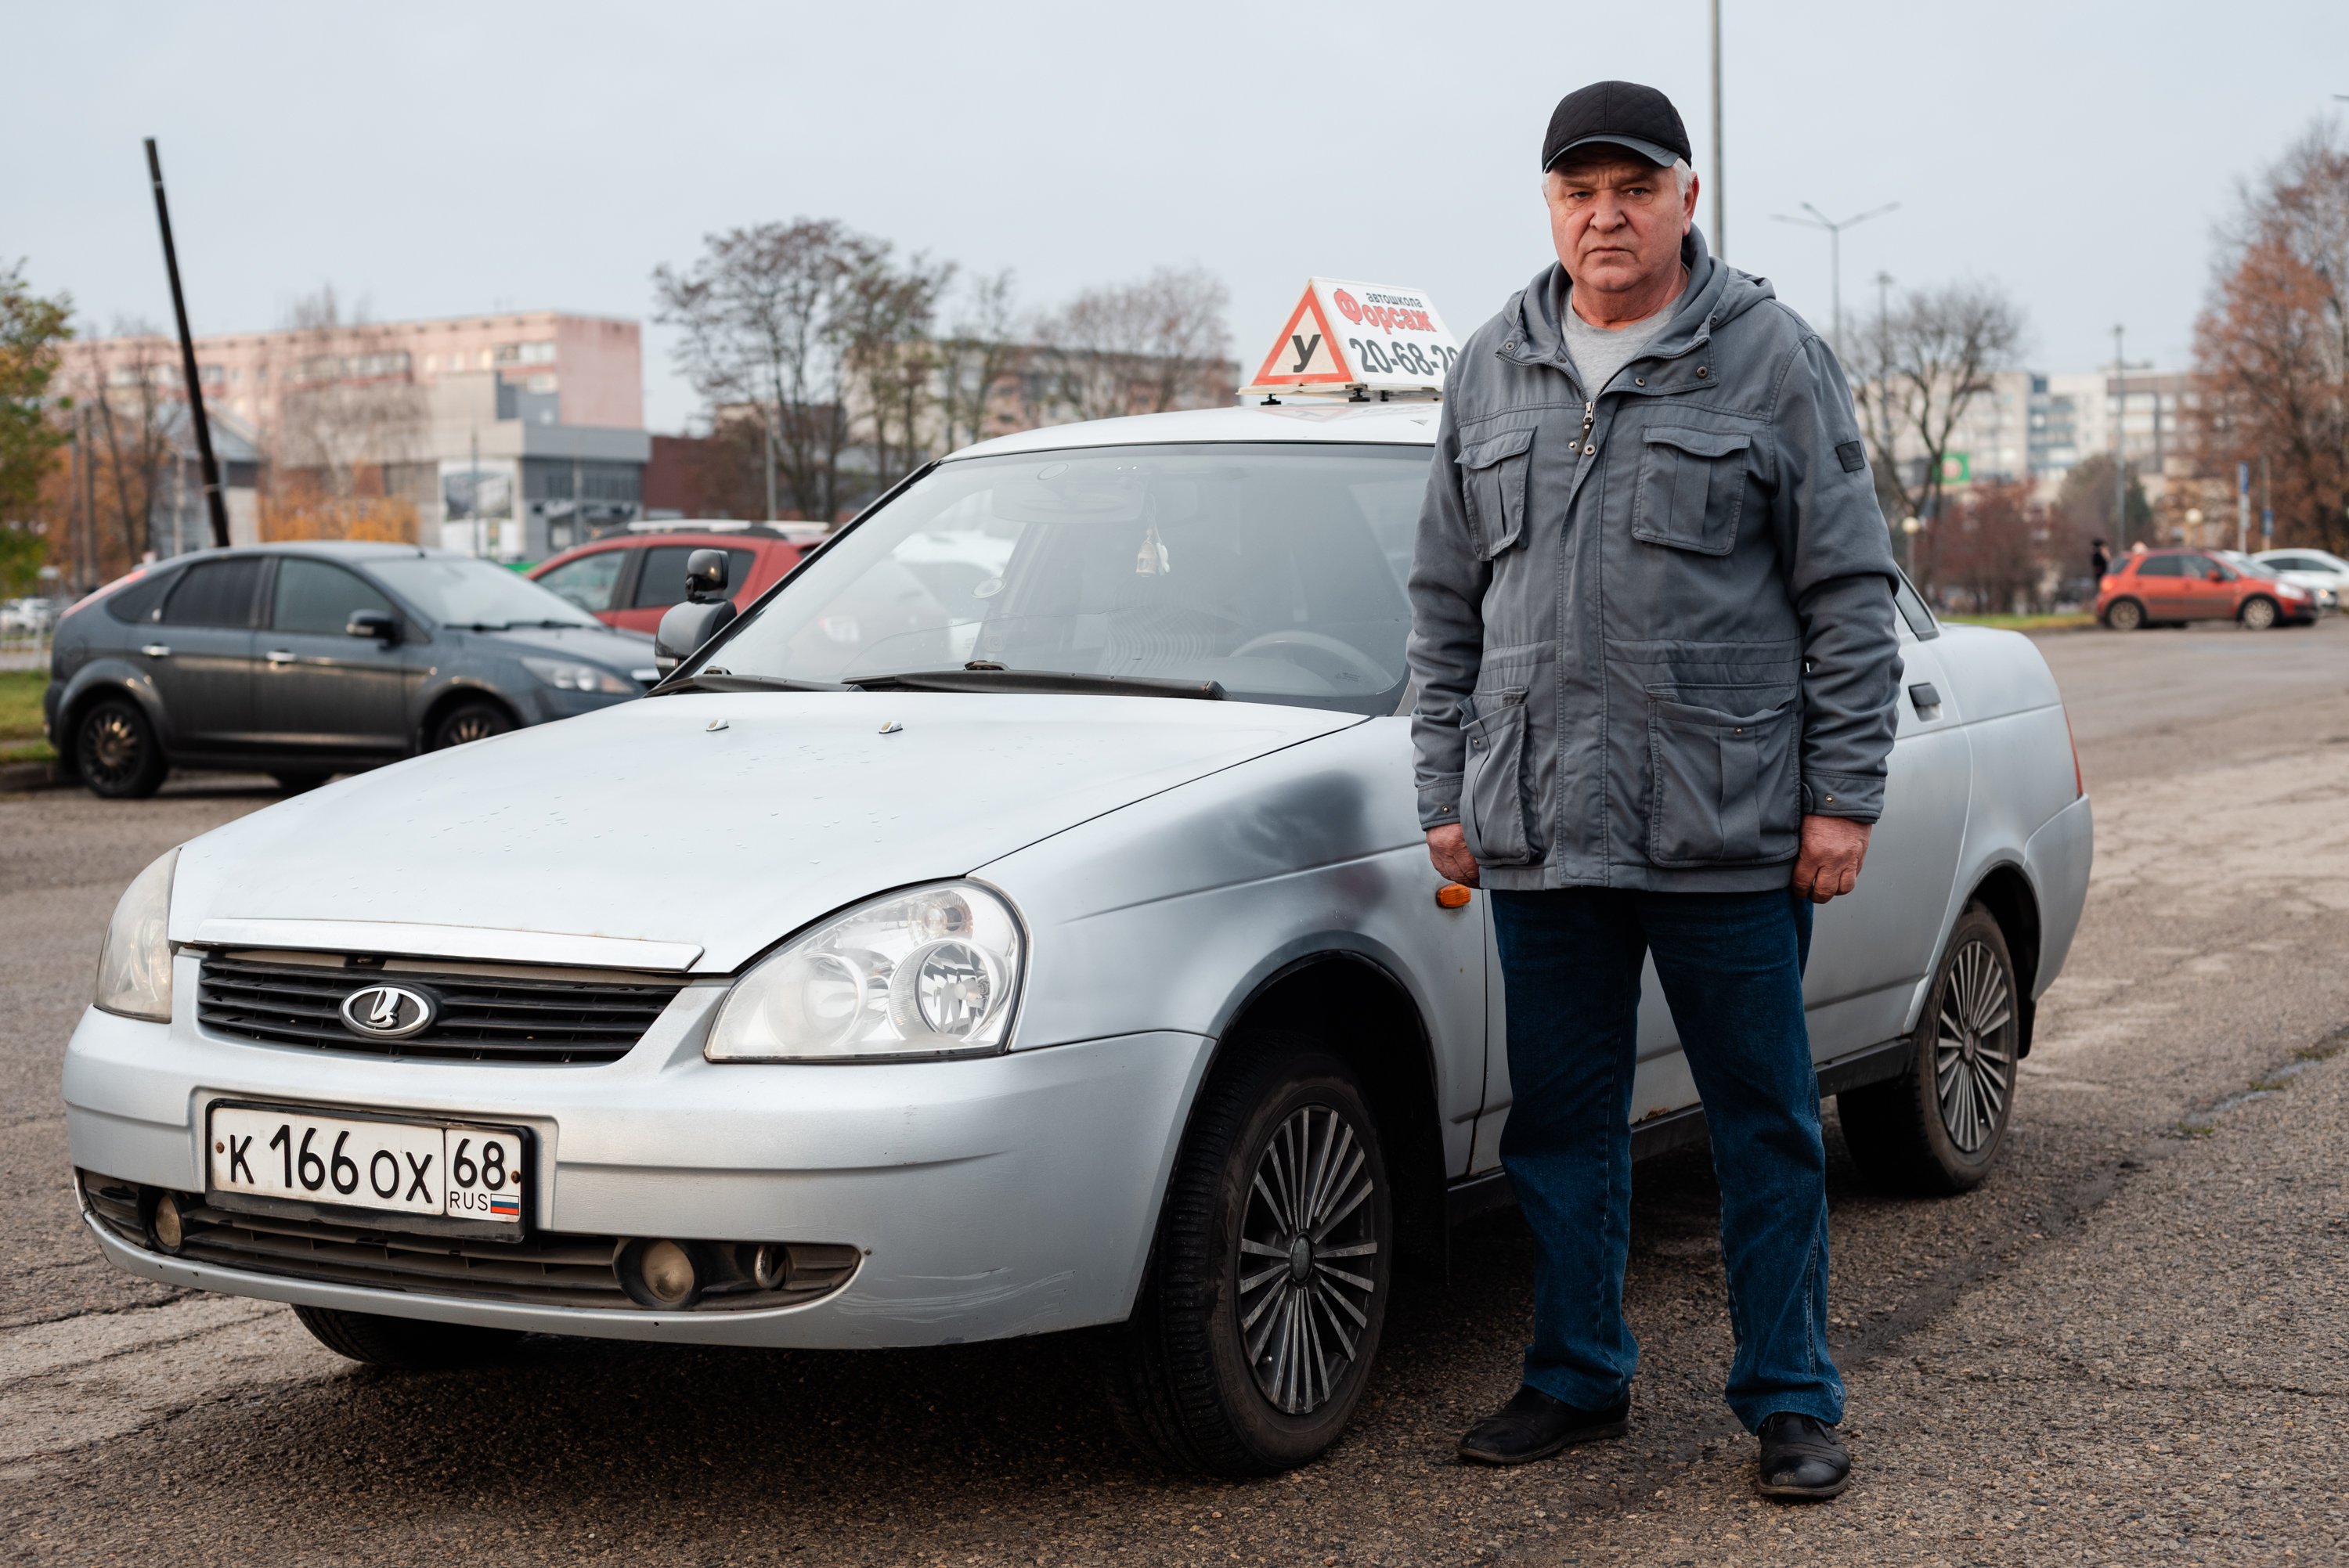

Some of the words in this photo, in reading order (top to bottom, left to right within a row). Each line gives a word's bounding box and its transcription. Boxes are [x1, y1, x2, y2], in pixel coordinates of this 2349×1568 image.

[1366, 291, 1423, 308] автошкола
[1333, 288, 1437, 334] Форсаж
[449, 1191, 489, 1212] RUS
